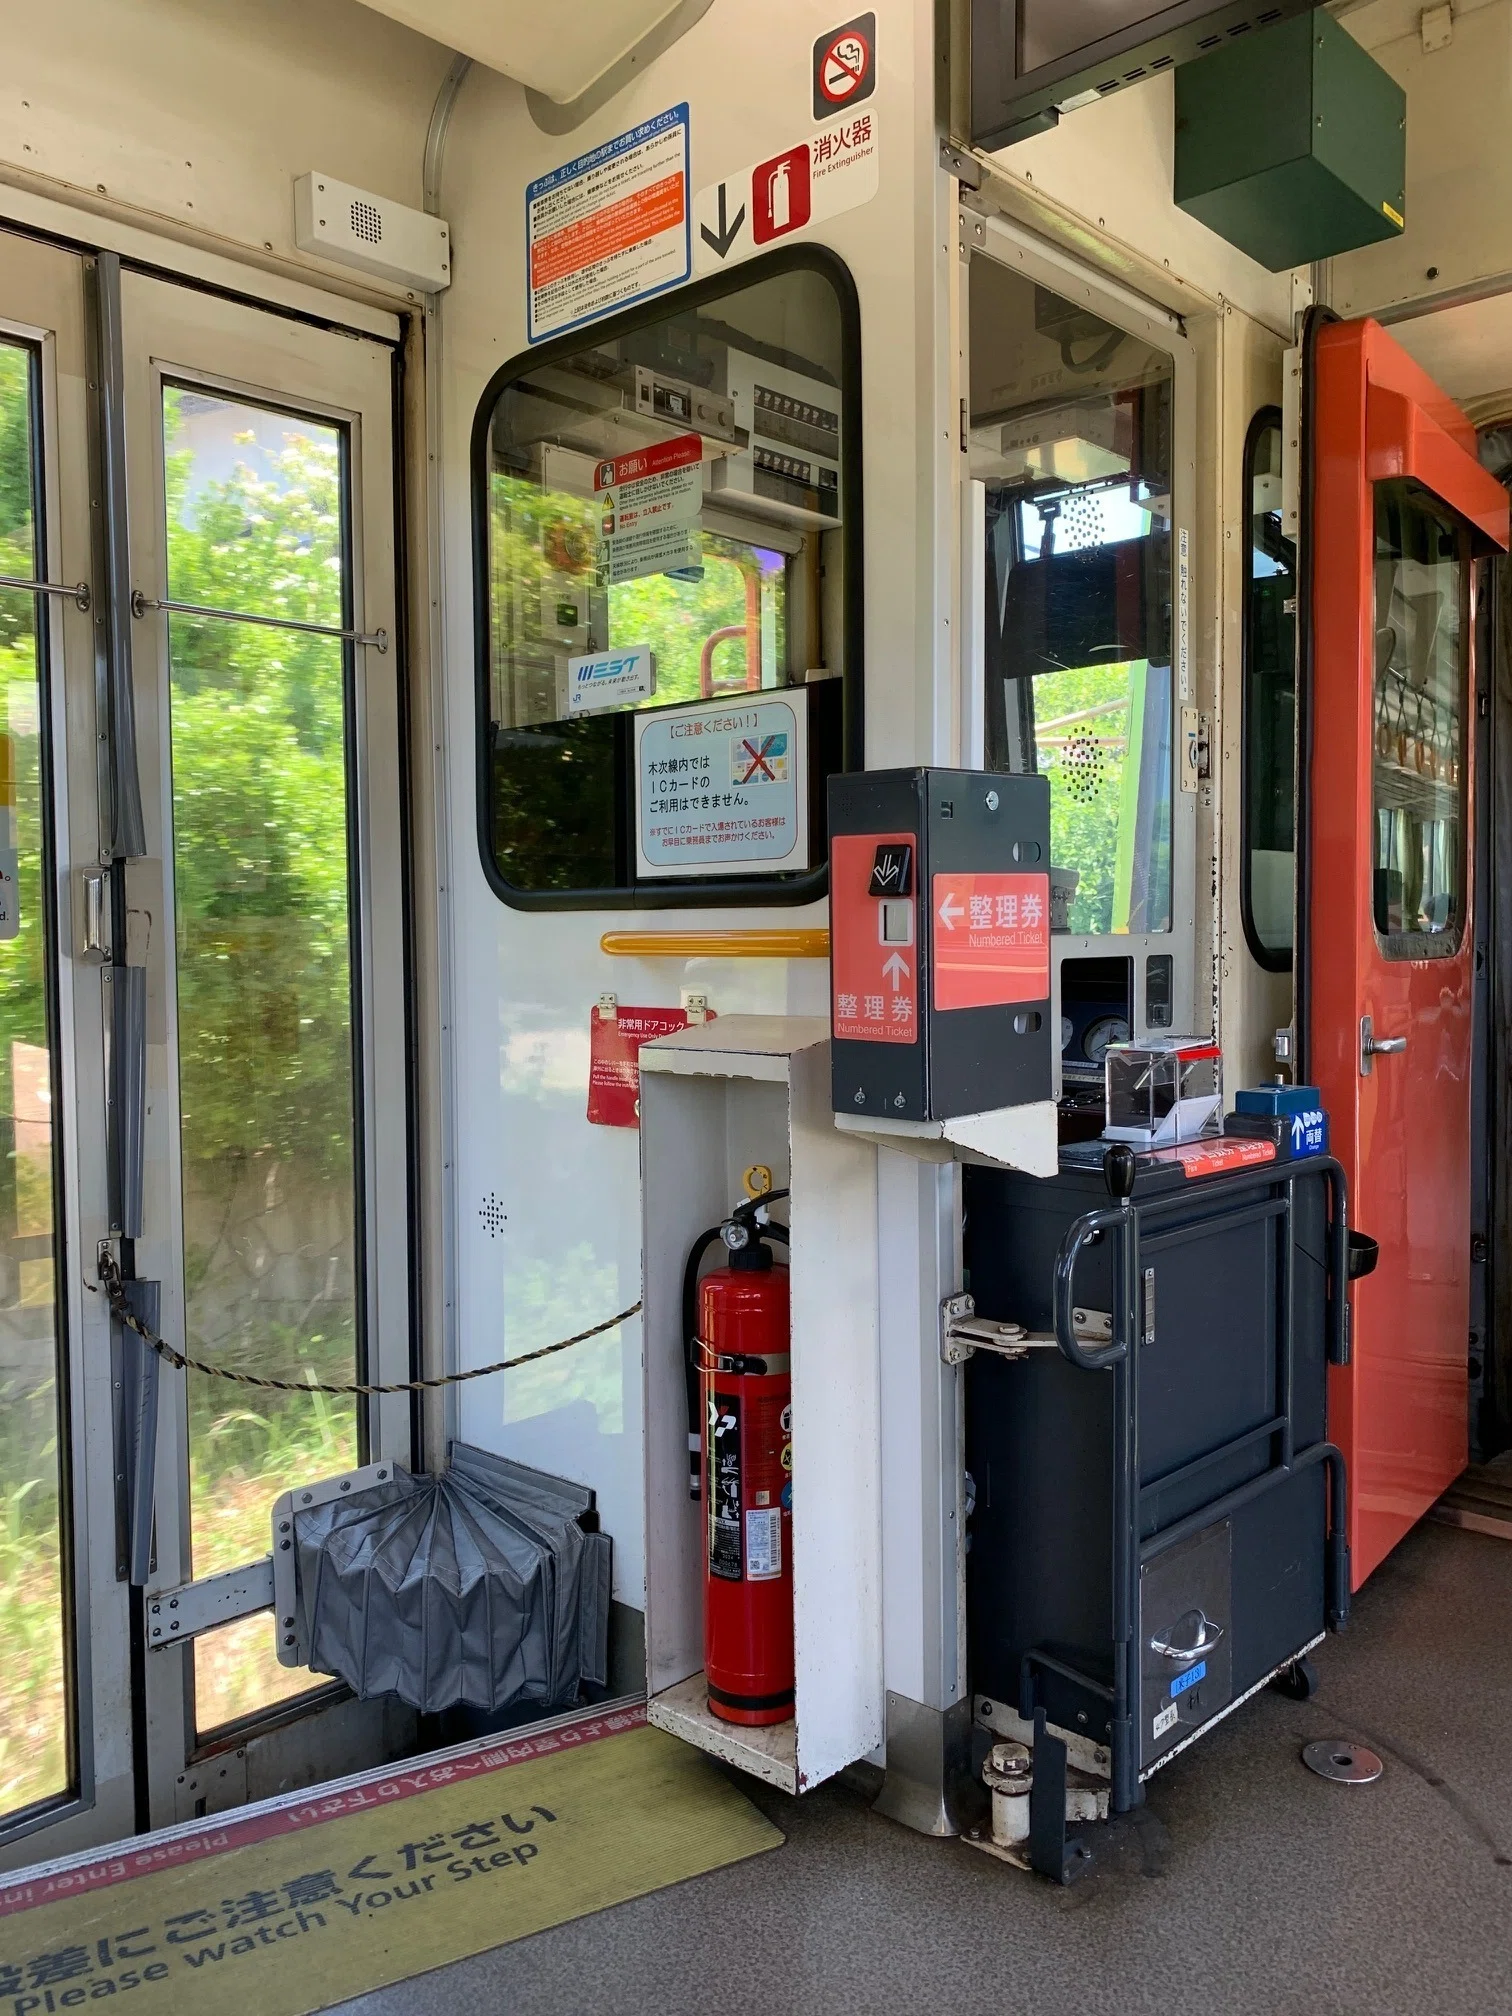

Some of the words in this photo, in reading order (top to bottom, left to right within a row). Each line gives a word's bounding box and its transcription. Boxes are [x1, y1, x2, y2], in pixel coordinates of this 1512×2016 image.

[813, 115, 872, 165] 消火器
[813, 168, 826, 179] Fire
[827, 146, 874, 173] Extinguisher
[619, 458, 647, 477] お願い
[1180, 564, 1188, 693] 触れないでください。
[670, 713, 758, 739] 【ご注意ください！】
[648, 755, 710, 775] 木次線内では
[652, 776, 710, 793] ICカードの
[649, 793, 748, 813] ご利用はできません。
[662, 830, 775, 847] お早目に乗務員までお声かけください。
[969, 893, 1043, 929] 整理券
[969, 933, 1016, 948] Numbered
[1018, 931, 1043, 945] Ticket
[837, 993, 913, 1022] 整理券
[618, 1018, 684, 1031] 非常用ドアコック
[838, 1022, 884, 1035] Numbered
[886, 1025, 913, 1037] Ticket
[1305, 1128, 1323, 1145] 両替
[1262, 1149, 1273, 1157] Ticket
[135, 1832, 229, 1867] Please
[43, 1861, 127, 1896] Enter
[14, 1961, 170, 2016] Please
[183, 1909, 327, 1968] watch
[335, 1874, 436, 1916] Your
[447, 1842, 539, 1883] Step
